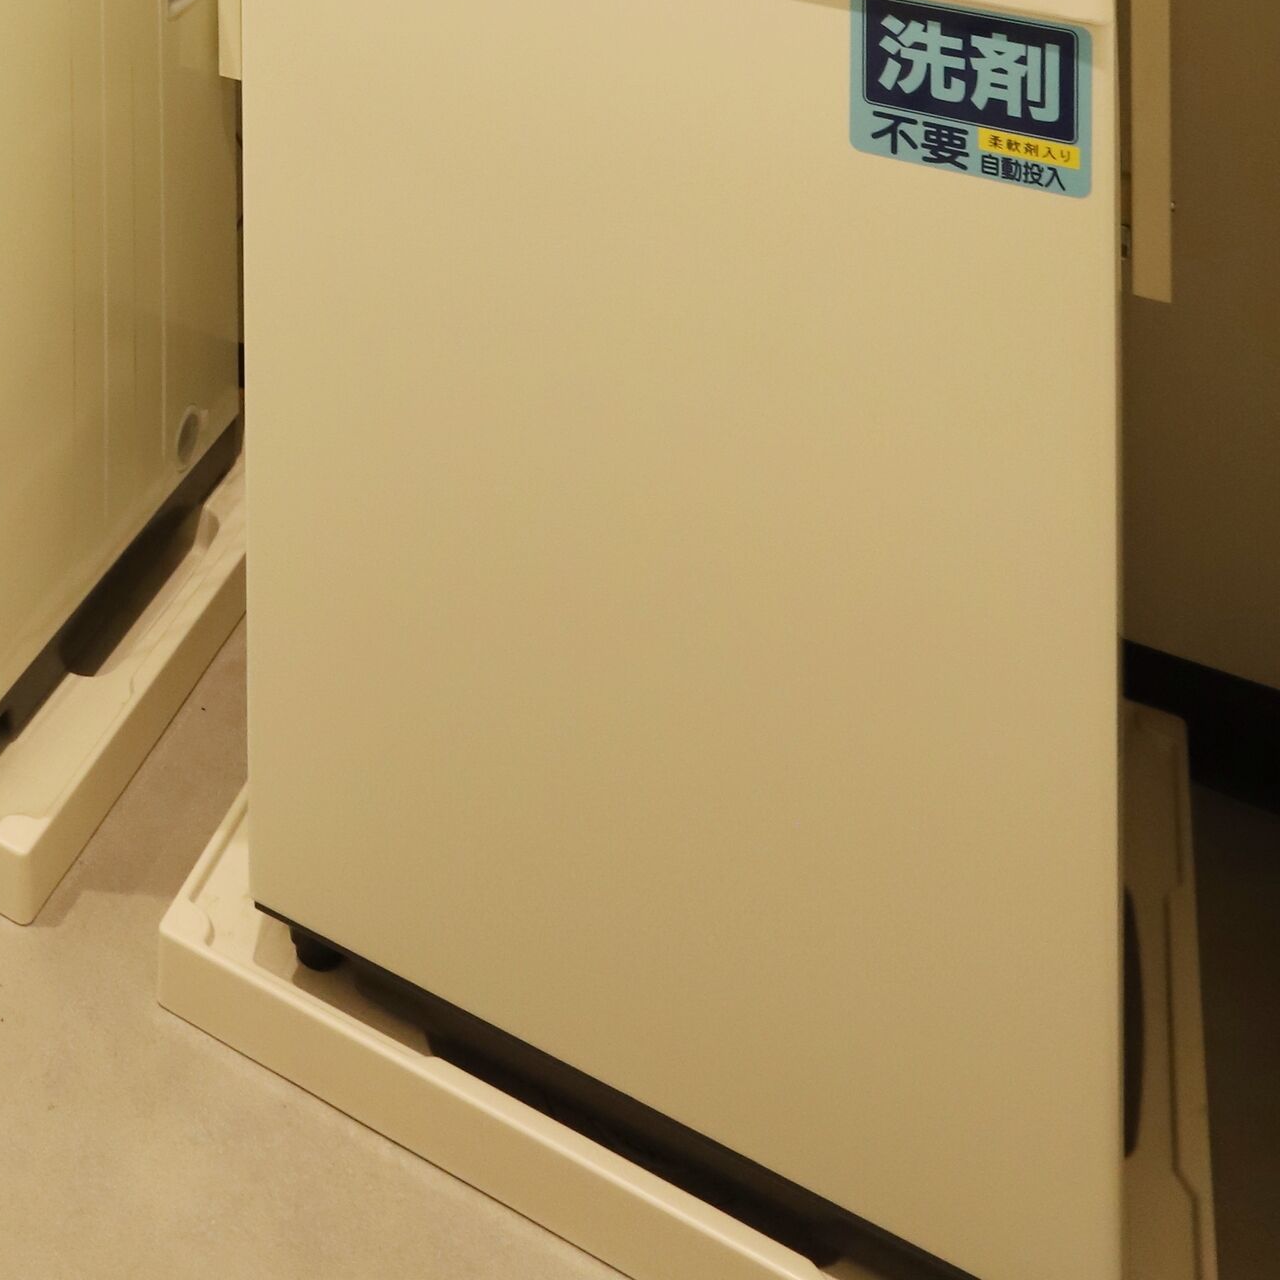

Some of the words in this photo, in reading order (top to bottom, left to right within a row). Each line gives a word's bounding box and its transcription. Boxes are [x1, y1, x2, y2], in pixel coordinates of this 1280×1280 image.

[877, 13, 1061, 123] 洗剤
[871, 110, 970, 171] 不要
[988, 134, 1072, 163] 柔軟剤入り
[980, 153, 1067, 191] 自動投入
